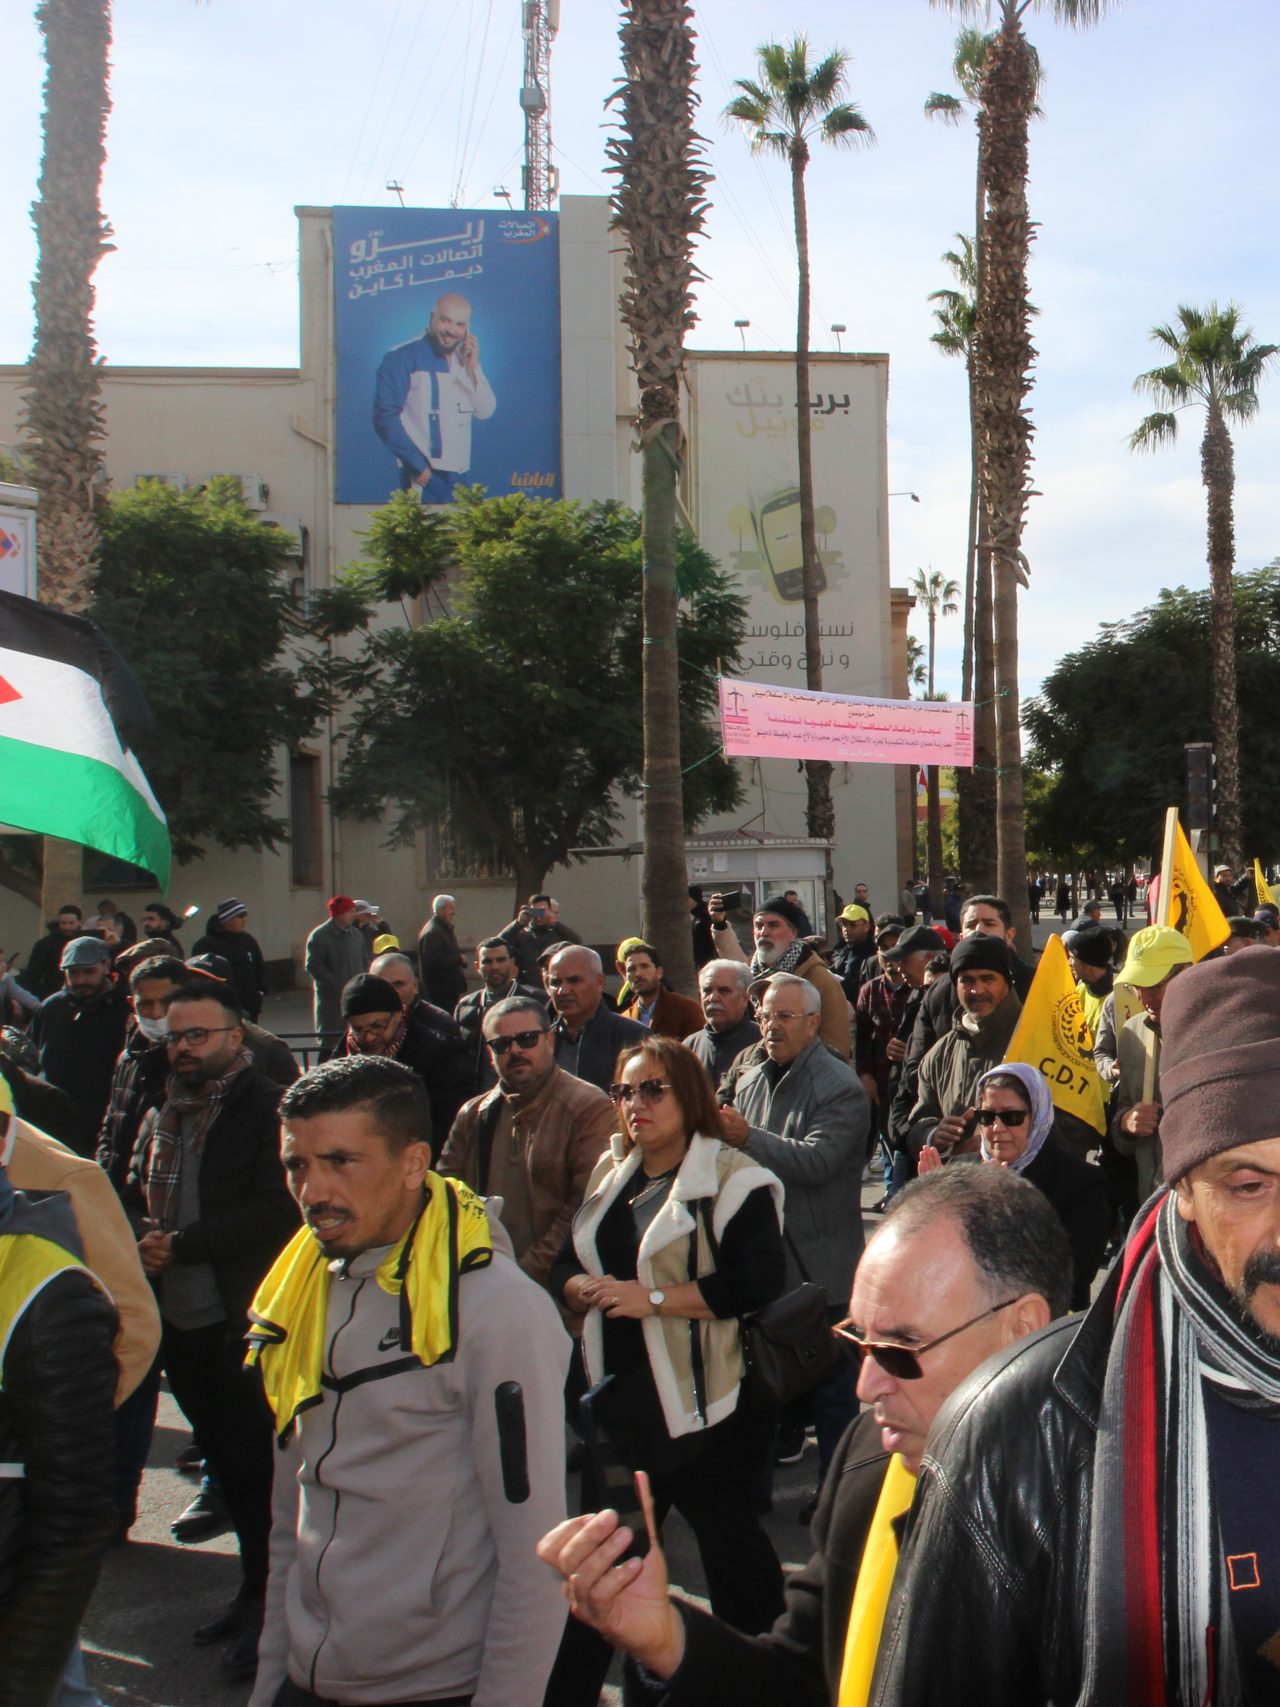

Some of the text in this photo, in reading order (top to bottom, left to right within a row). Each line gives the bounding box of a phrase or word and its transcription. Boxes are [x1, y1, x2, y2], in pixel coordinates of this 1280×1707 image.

[349, 244, 483, 280] اتصالات المغرب
[794, 393, 851, 415] بري
[744, 620, 805, 641] فلوس
[1039, 1057, 1090, 1095] C.D.T
